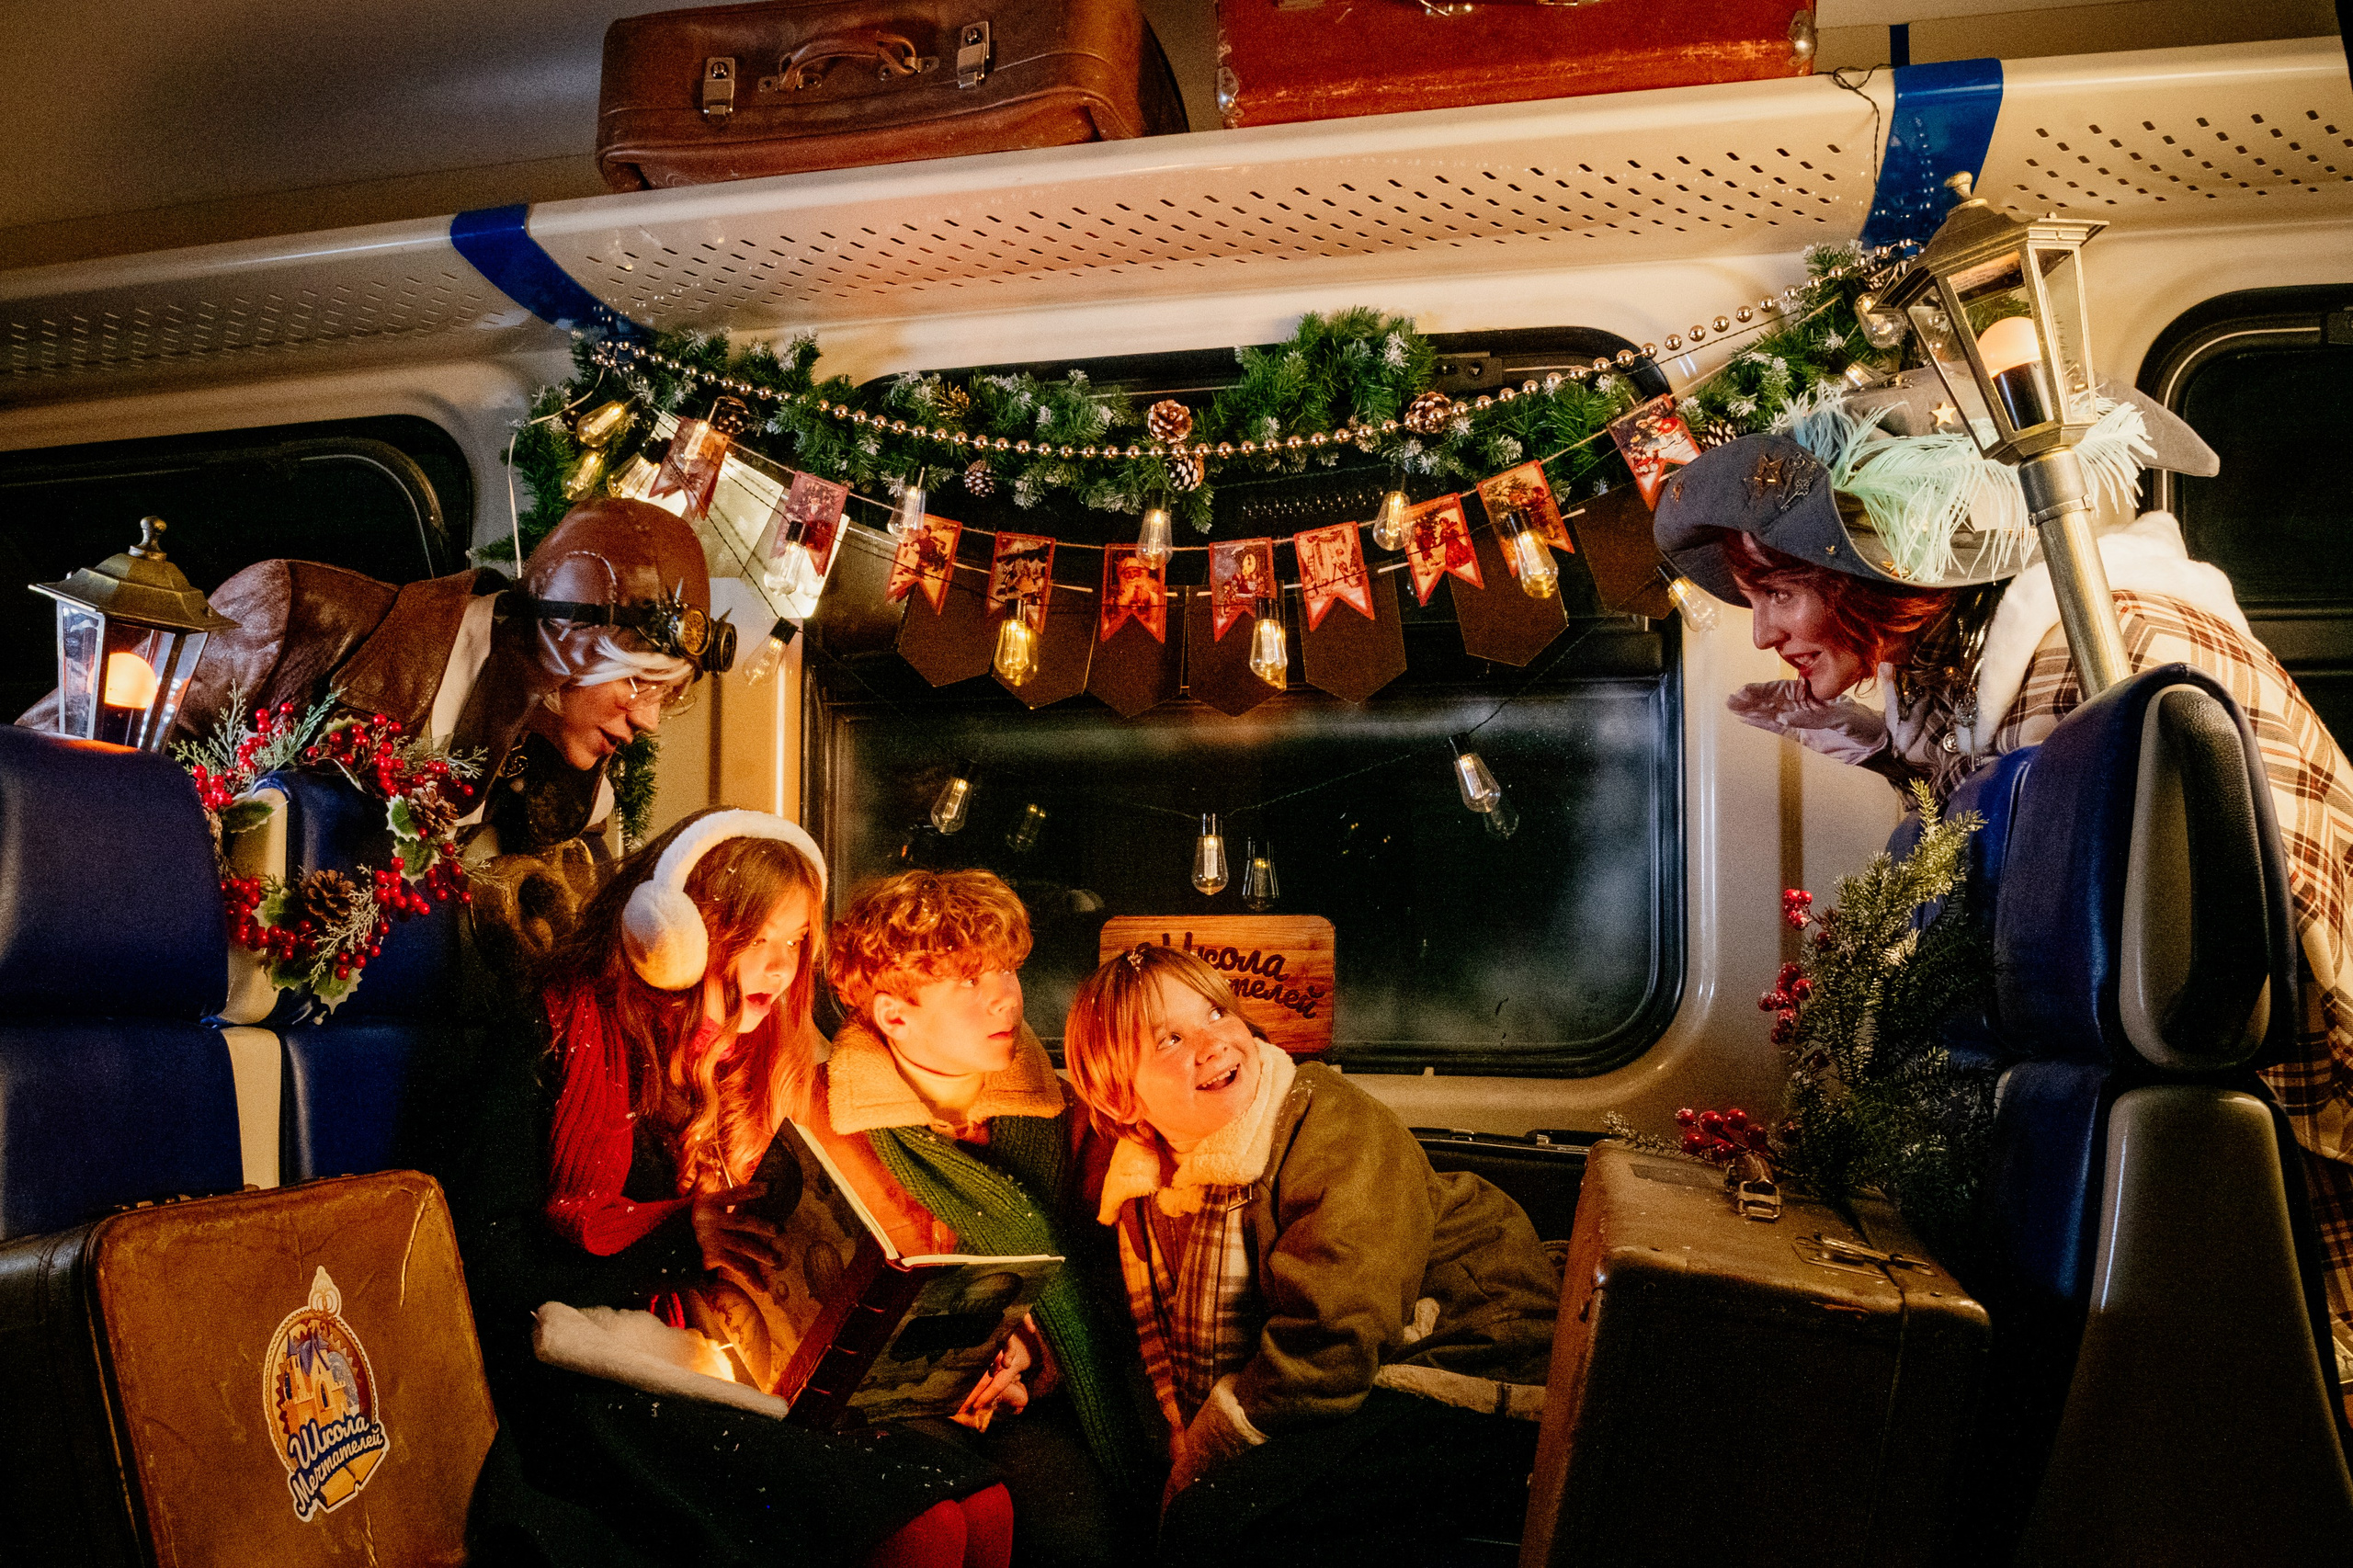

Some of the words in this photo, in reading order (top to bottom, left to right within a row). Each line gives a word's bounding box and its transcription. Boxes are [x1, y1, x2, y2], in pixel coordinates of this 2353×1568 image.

[1229, 978, 1325, 1019] телей
[290, 1415, 369, 1469] Школа
[292, 1426, 382, 1512] Мечтателей
